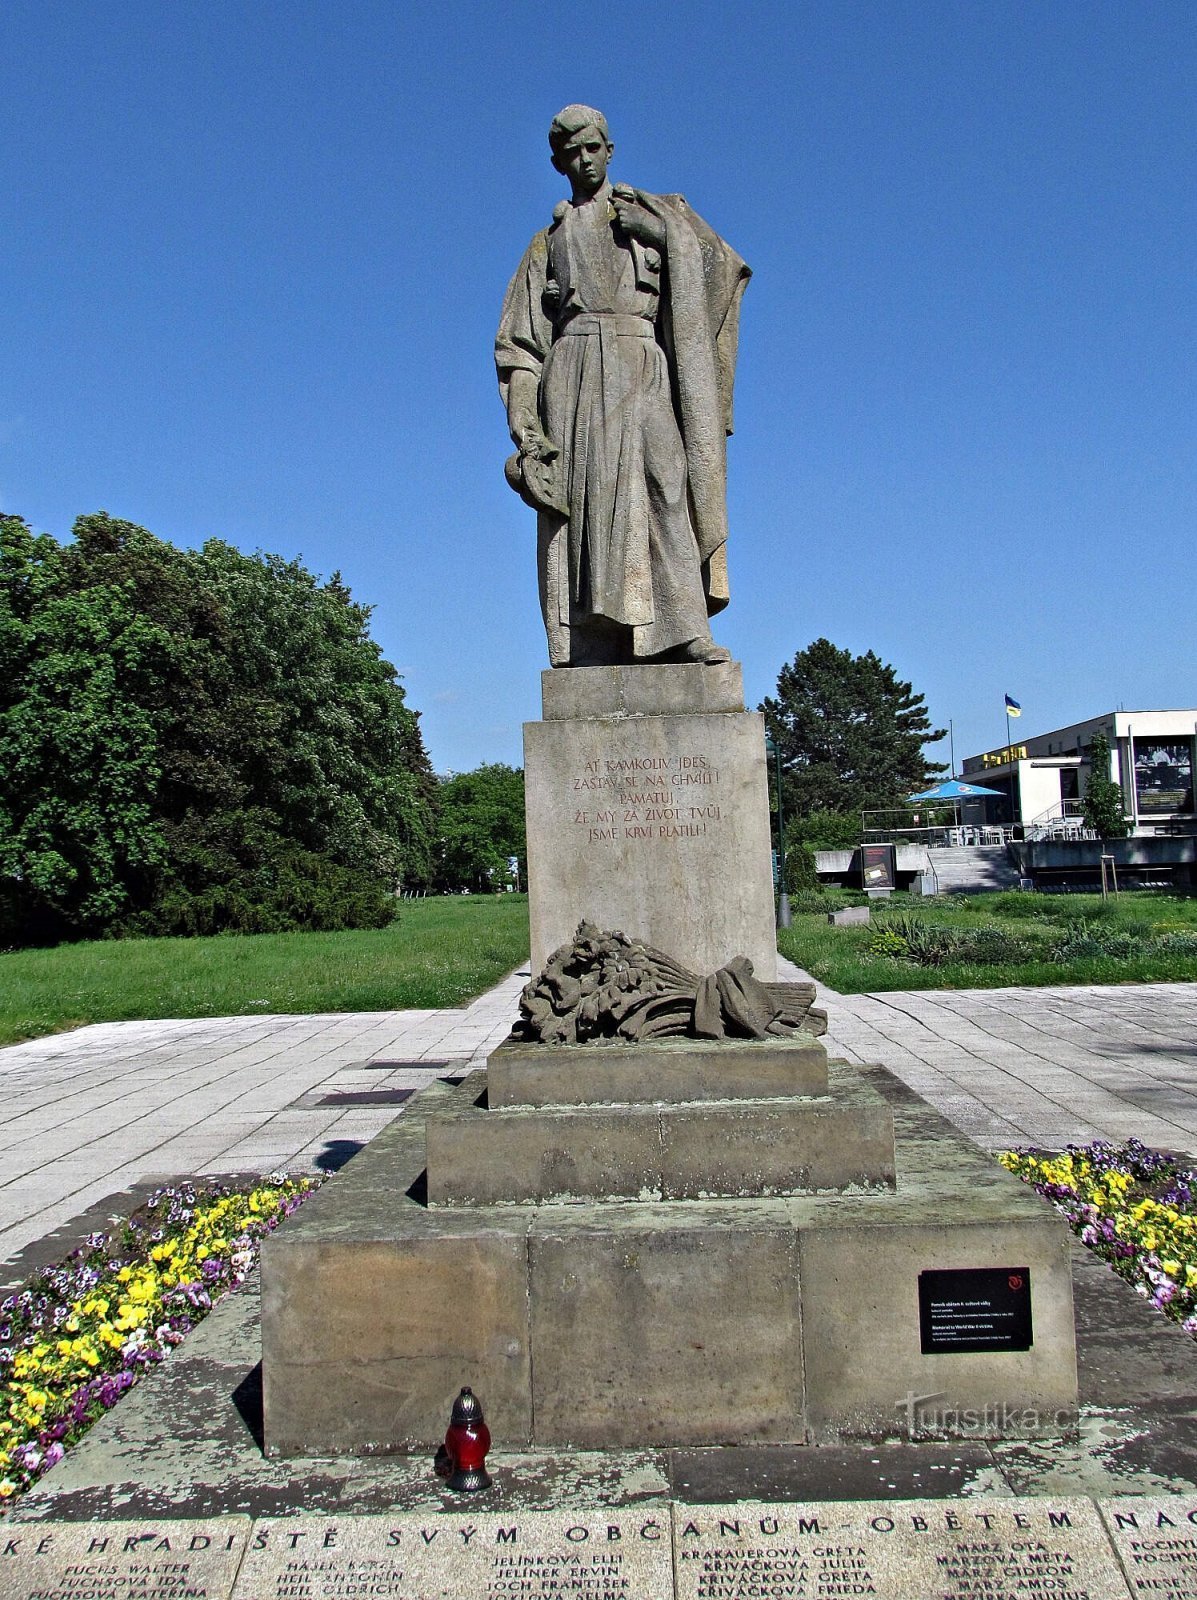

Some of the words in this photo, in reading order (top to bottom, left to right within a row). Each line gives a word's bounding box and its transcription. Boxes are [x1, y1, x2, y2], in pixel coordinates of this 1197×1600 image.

[607, 757, 671, 772] KAMKOLIV
[625, 776, 637, 788] SE
[646, 775, 665, 787] NA
[575, 809, 589, 824] ŽE
[596, 811, 616, 823] MY
[624, 810, 638, 822] ZA
[645, 807, 681, 821] ŽIVOT
[588, 828, 618, 843] JSME
[625, 824, 653, 839] KRVÍ
[86, 1527, 338, 1554] HRADIŠTĚ
[386, 1525, 518, 1548] SVÝM
[565, 1517, 821, 1542] OBČANŮM
[871, 1509, 1073, 1532] OBĚTEM
[1011, 1541, 1046, 1553] OTA
[593, 1554, 622, 1564] ELLI
[820, 1559, 866, 1570] JULIE
[1028, 1552, 1075, 1564] META
[65, 1564, 118, 1576] FUCHS
[129, 1563, 190, 1575] WALTER
[496, 1566, 560, 1578] JELÍNEK
[571, 1566, 619, 1577] ERVIN
[1003, 1565, 1073, 1577] GIDEON
[59, 1575, 148, 1588] FUCHSOVÁ
[158, 1576, 188, 1587] IDA
[276, 1572, 311, 1584] HEIL
[1017, 1578, 1067, 1590] AMOS
[276, 1584, 311, 1597] HEIL
[486, 1580, 531, 1592] JOCH
[541, 1578, 630, 1591] FRANTIŠEK
[818, 1584, 877, 1596] FRIEDA
[28, 1588, 116, 1600] FUCHSOVÁ
[127, 1587, 207, 1600] KATEŘINA
